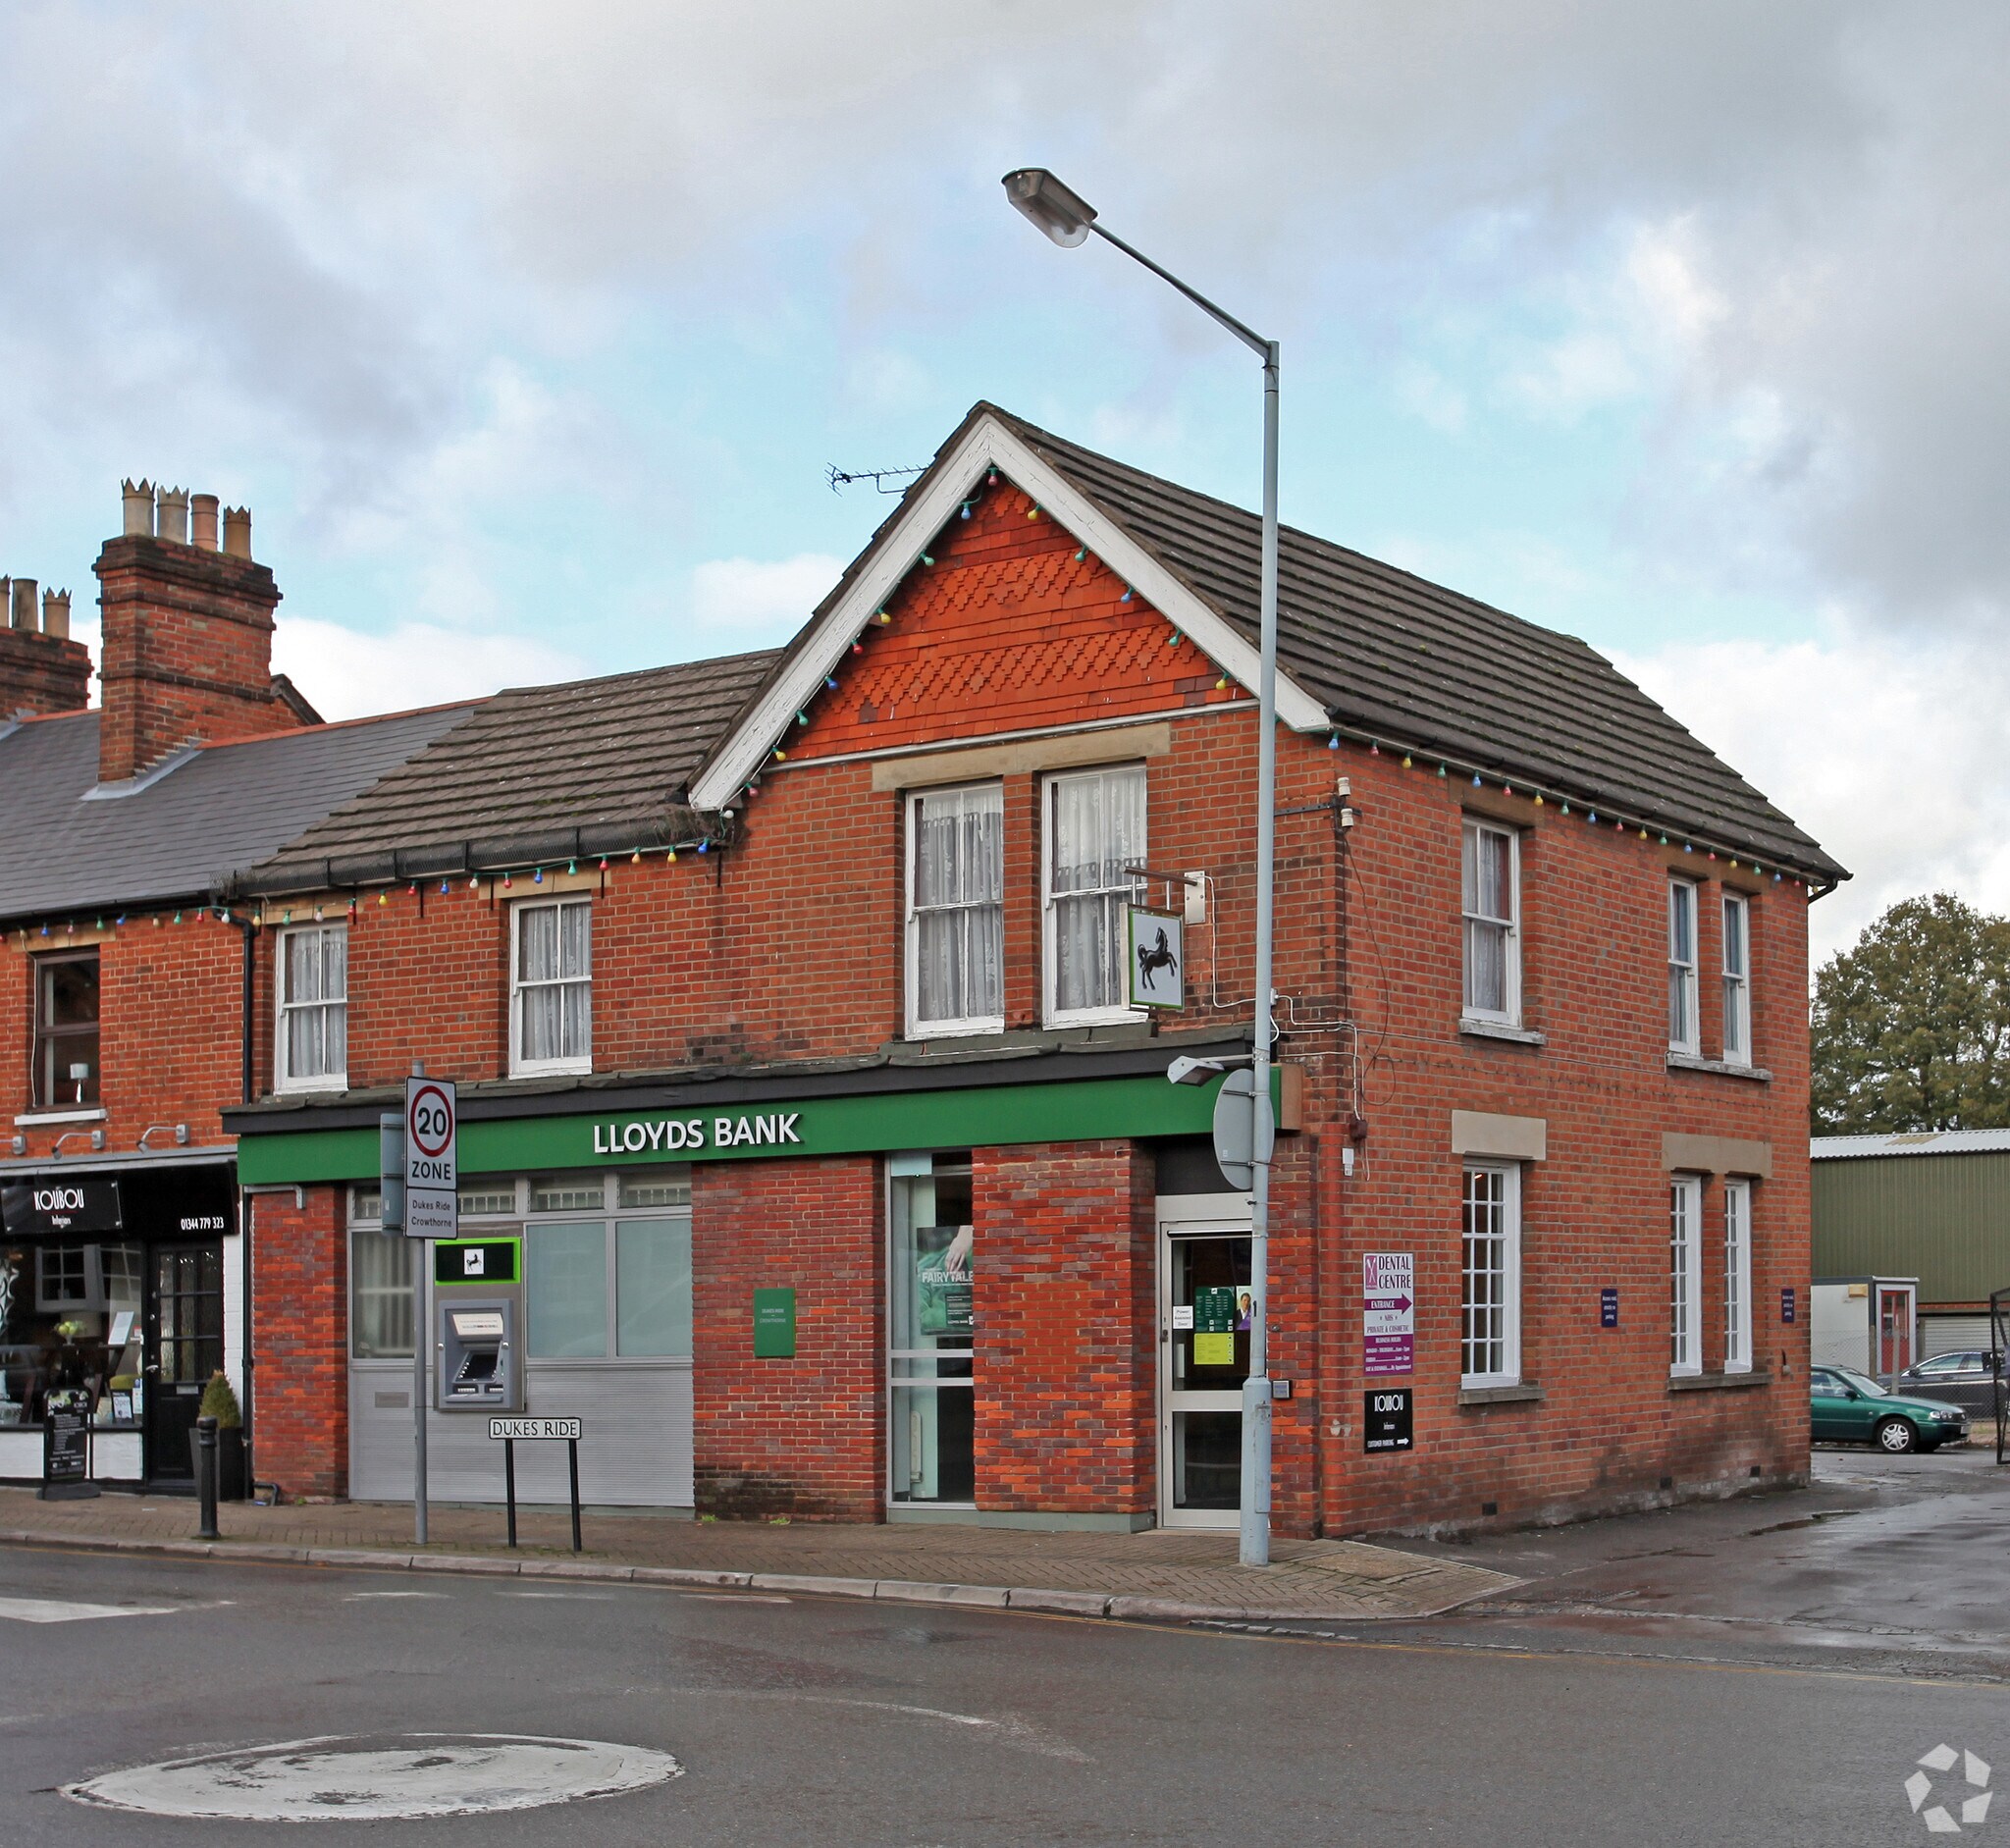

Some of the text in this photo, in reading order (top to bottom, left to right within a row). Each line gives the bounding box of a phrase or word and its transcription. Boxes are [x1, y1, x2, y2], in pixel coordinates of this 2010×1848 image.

[418, 1107, 447, 1136] 20
[593, 1113, 801, 1153] LLOYDS BANK
[411, 1161, 451, 1181] ZONE
[33, 1188, 84, 1211] KOUBOU
[412, 1199, 450, 1211] Dukes Ride
[181, 1217, 225, 1231] 01344 779 323
[411, 1216, 452, 1228] Crowthorne
[1378, 1256, 1411, 1271] DENTAL
[1378, 1275, 1411, 1290] CENTRE
[1371, 1300, 1395, 1309] ENTRANCE
[493, 1421, 577, 1436] DUKES RIDE
